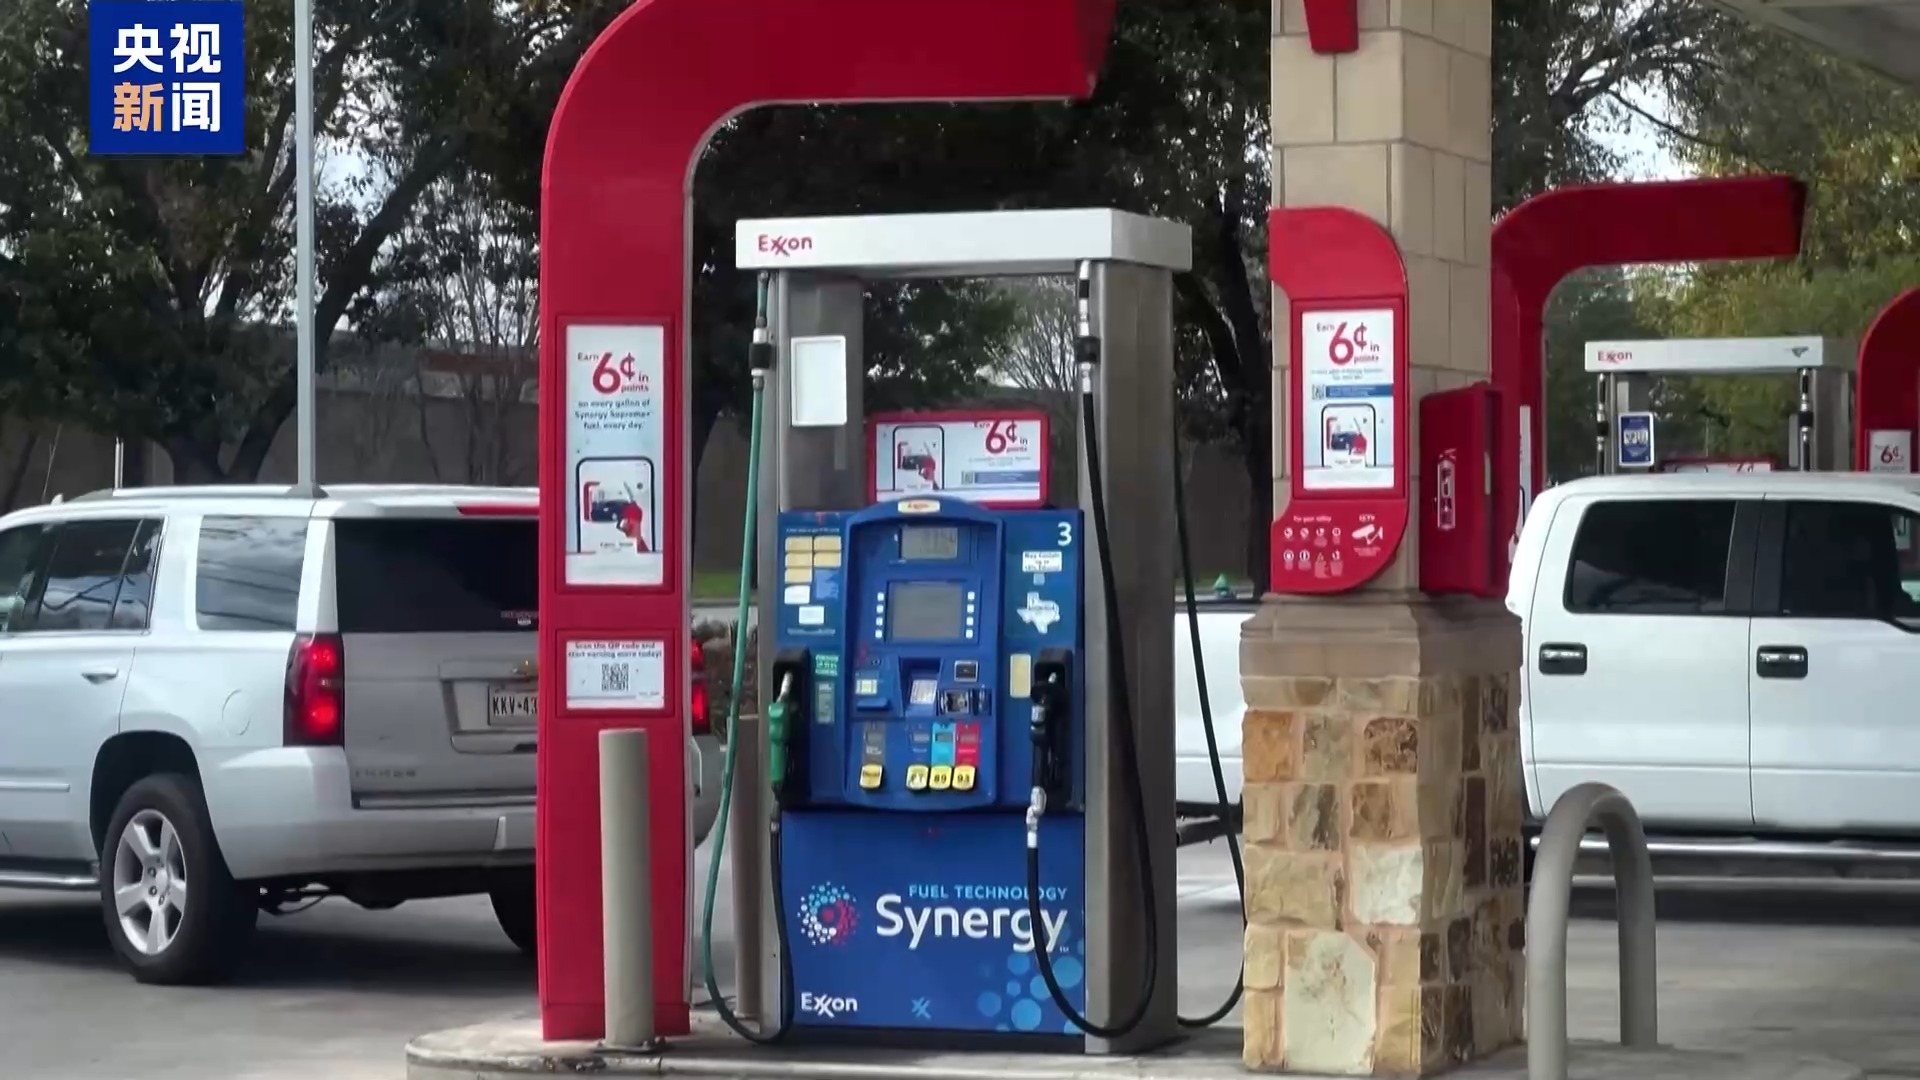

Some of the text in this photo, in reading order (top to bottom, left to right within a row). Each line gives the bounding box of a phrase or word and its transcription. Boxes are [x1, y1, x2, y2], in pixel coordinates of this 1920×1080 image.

[758, 234, 812, 257] Exxon
[1329, 322, 1367, 366] 6¢
[1370, 341, 1379, 352] in
[1598, 350, 1633, 364] Exxon
[577, 352, 649, 394] Earn 6¢ in
[621, 384, 649, 393] points
[985, 420, 1017, 454] 6¢
[1058, 521, 1072, 546] 3
[909, 885, 949, 899] FUEL
[876, 894, 1068, 954] Synergy
[801, 992, 859, 1018] Exxon
